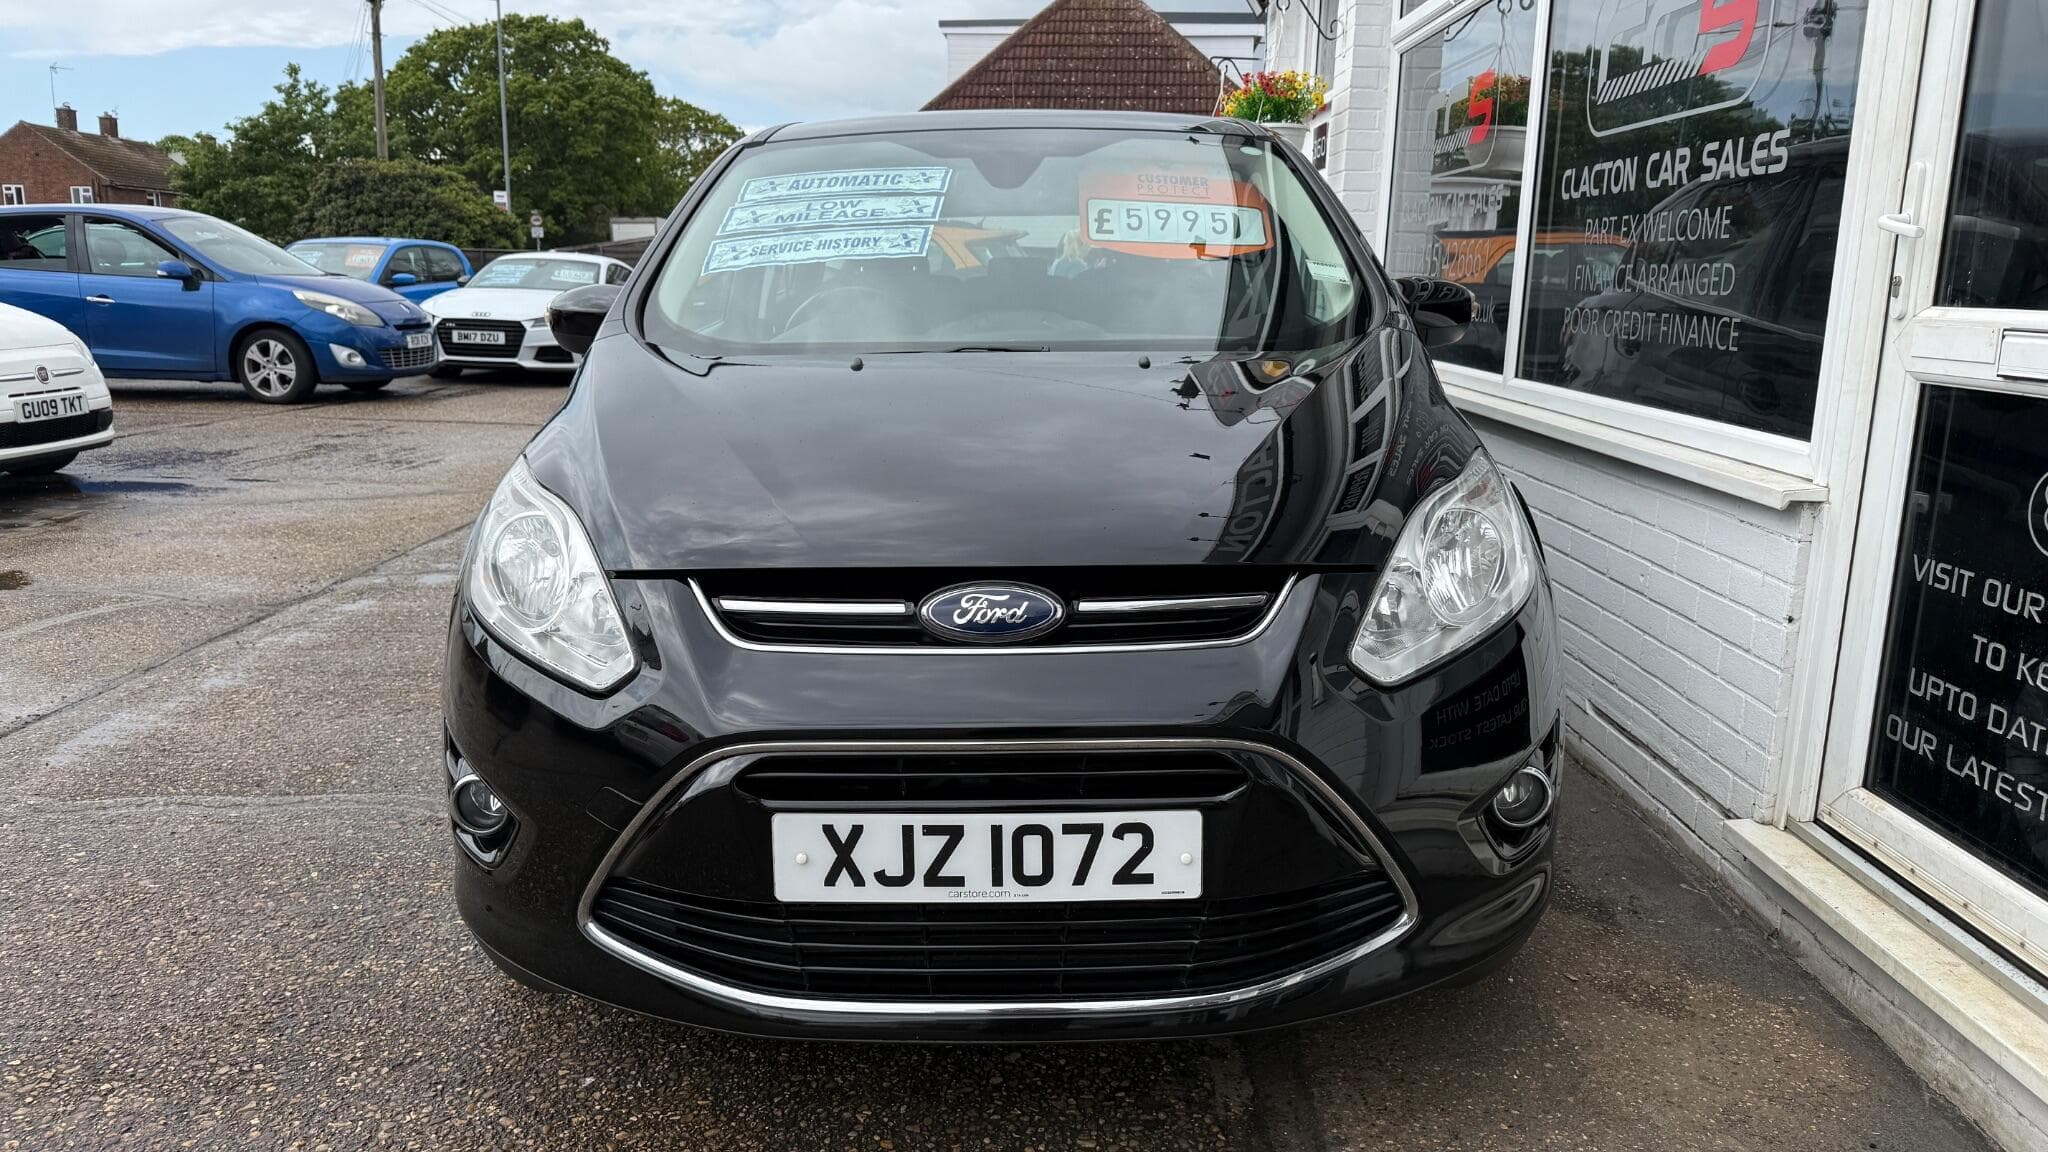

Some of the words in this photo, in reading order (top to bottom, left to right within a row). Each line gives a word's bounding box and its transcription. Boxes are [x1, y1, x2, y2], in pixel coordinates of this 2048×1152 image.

[1561, 156, 1638, 200] CLACTON
[1646, 147, 1691, 189] CAR
[1700, 128, 1791, 182] SALES
[788, 174, 903, 192] AUTOMATIC
[1137, 174, 1208, 186] CUSTOMER
[1137, 184, 1209, 195] PROTECT
[774, 208, 885, 224] MILEAGE
[806, 200, 862, 212] LOW
[1094, 208, 1228, 236] £5995
[1585, 216, 1618, 246] PART
[1620, 214, 1640, 245] EX
[1643, 205, 1733, 243] WELCOME
[750, 240, 812, 258] SERVICE
[817, 235, 883, 251] HISTORY
[1574, 263, 1634, 293] FINANCE
[1636, 262, 1736, 296] ARRANGED
[457, 331, 478, 341] BM17
[480, 333, 500, 342] DZU
[1563, 307, 1599, 337] POOR
[1603, 309, 1656, 342] CREDIT
[1659, 313, 1742, 352] FINANCE
[21, 399, 59, 419] GU09
[61, 395, 83, 414] TKT
[1914, 553, 1976, 597] VISIT
[1982, 578, 2046, 624] OUR
[953, 594, 1029, 625] Ford
[1973, 633, 2007, 672] TO
[1909, 667, 1977, 721] UPTO
[1987, 702, 2048, 755] DAT
[1886, 713, 1938, 761] OUR
[1946, 743, 2048, 821] LATEST
[822, 824, 966, 888] XJZ
[990, 822, 1154, 887] 1072
[947, 889, 1012, 898] carstore.com
